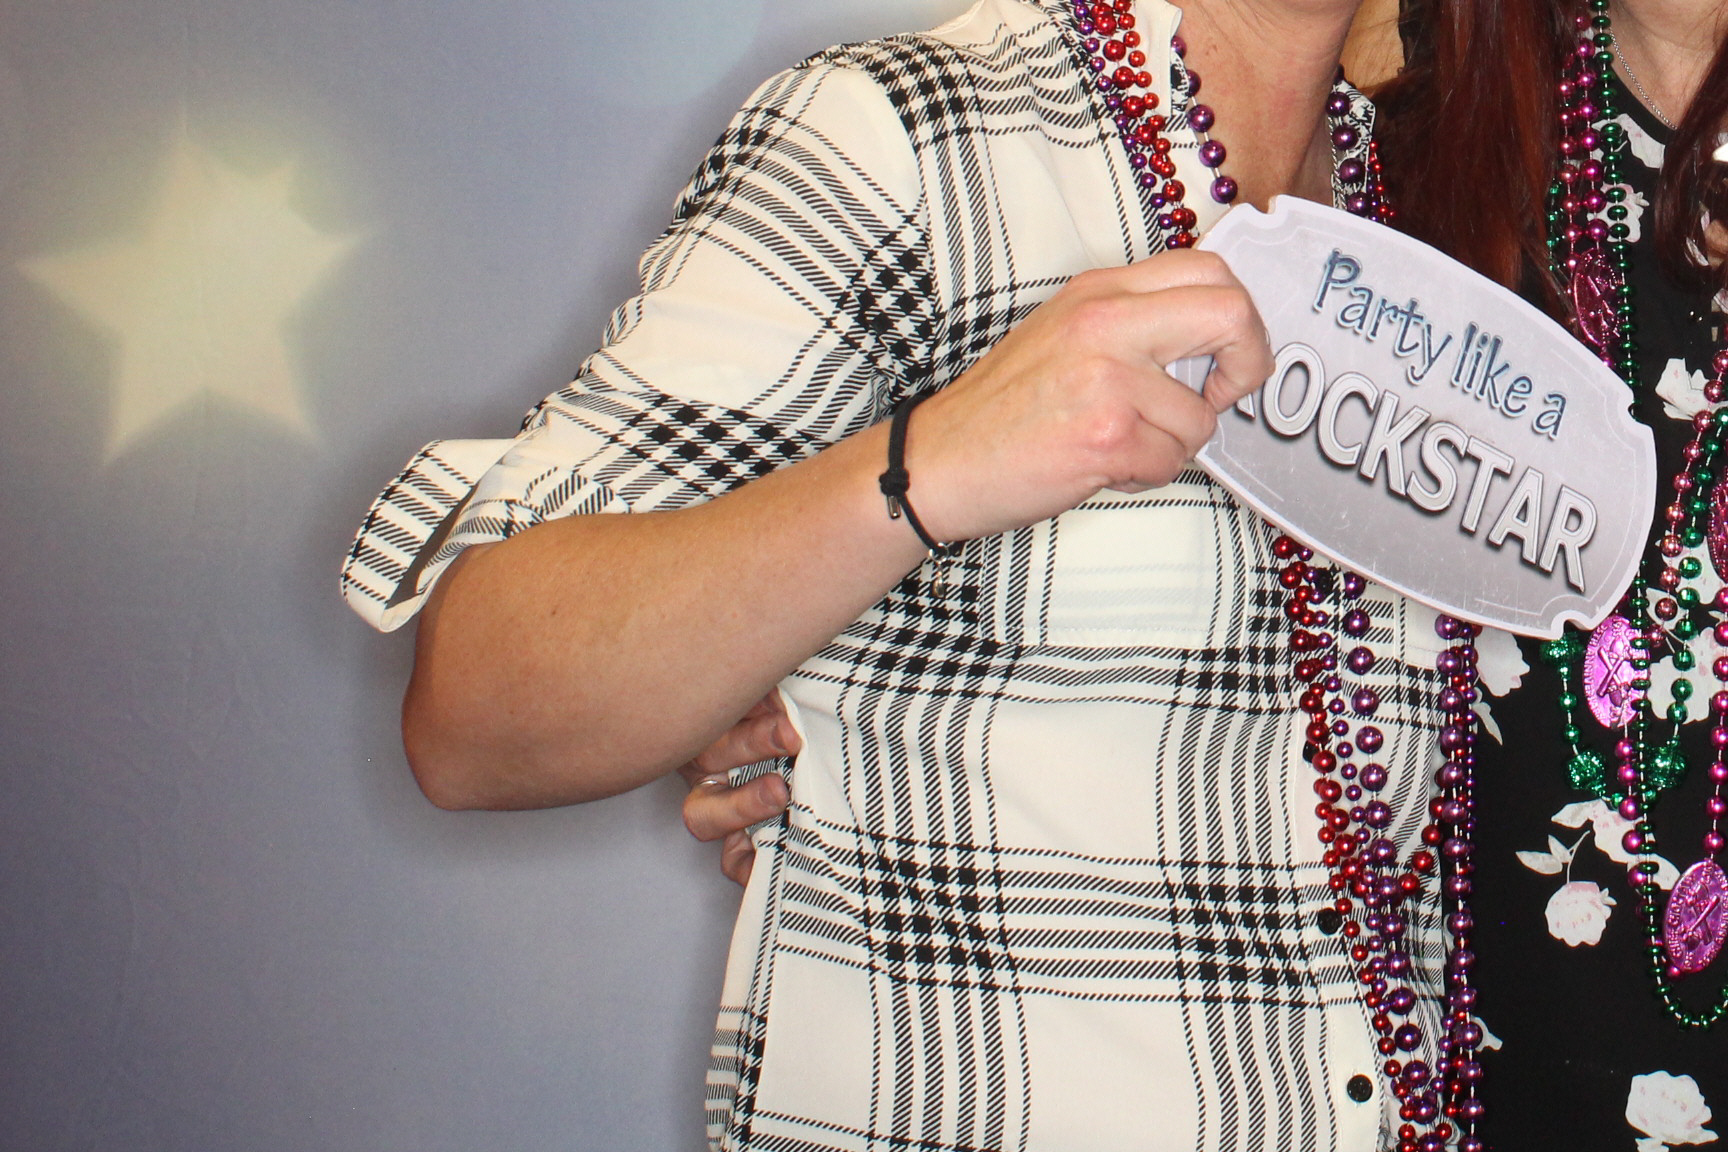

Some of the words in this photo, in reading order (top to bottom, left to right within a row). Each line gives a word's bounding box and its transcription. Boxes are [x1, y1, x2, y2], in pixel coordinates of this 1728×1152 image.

[1313, 248, 1452, 385] Party
[1450, 321, 1534, 419] like
[1533, 389, 1567, 440] a
[1234, 342, 1597, 593] OCKSTAR
